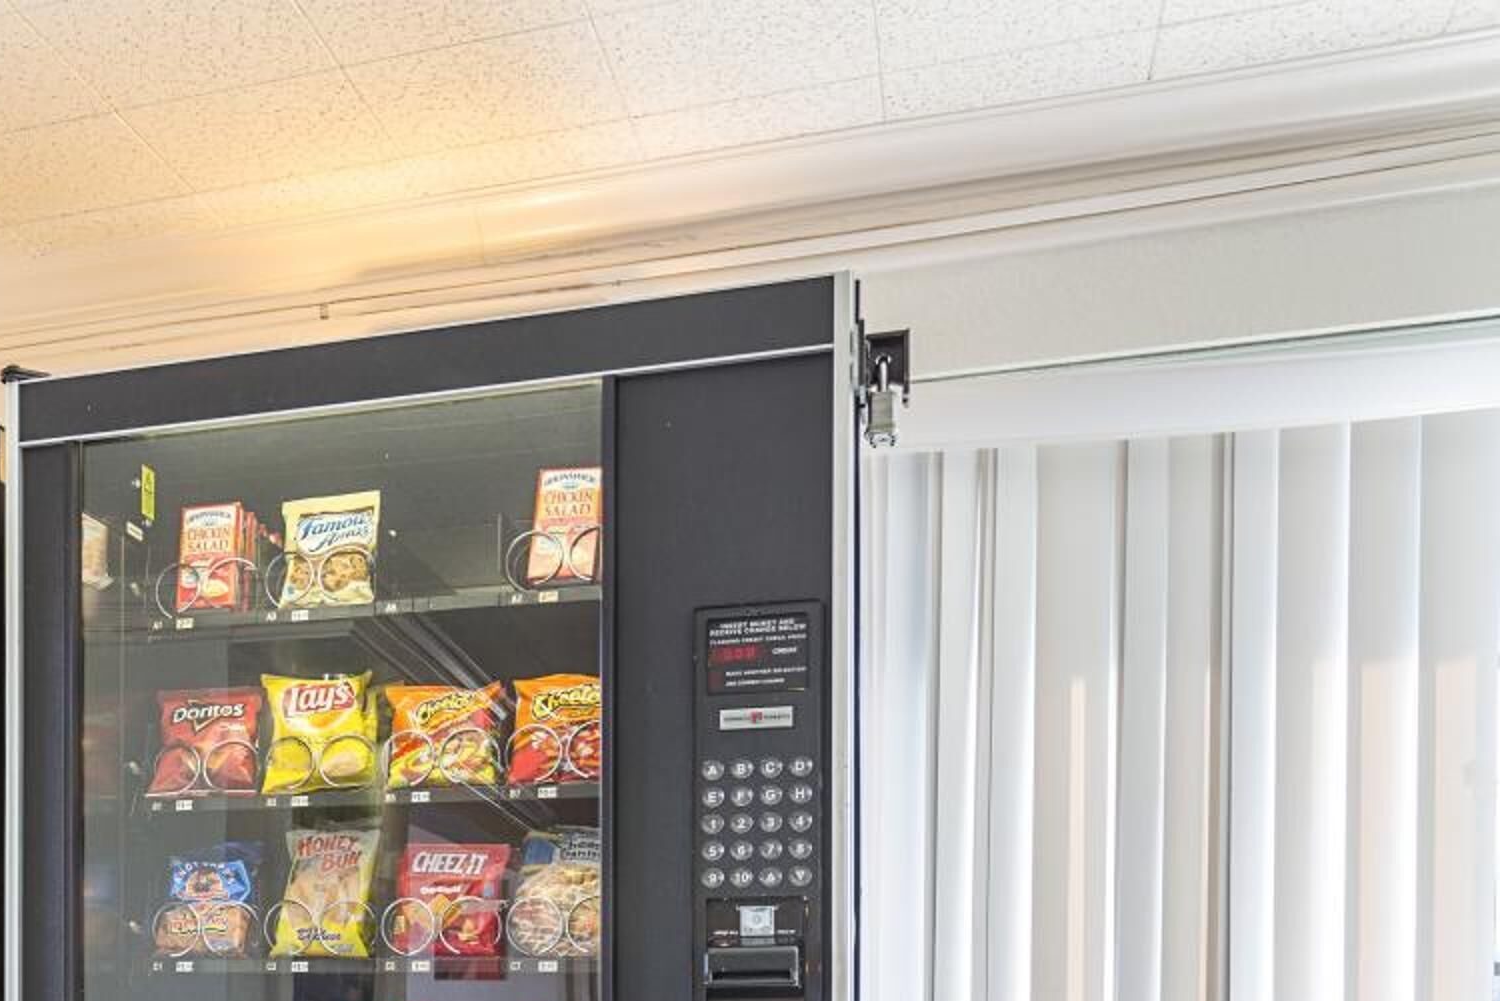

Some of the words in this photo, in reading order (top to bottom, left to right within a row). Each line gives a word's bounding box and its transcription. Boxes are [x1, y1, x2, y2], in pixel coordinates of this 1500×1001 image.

[544, 490, 593, 504] CHICKEN
[545, 503, 591, 516] SALAD
[187, 527, 230, 541] CHICKEN
[287, 682, 352, 716] Lay's
[532, 683, 600, 720] Cheeto
[173, 703, 245, 724] Doritos
[296, 834, 360, 858] HONEY
[321, 850, 362, 873] BUN
